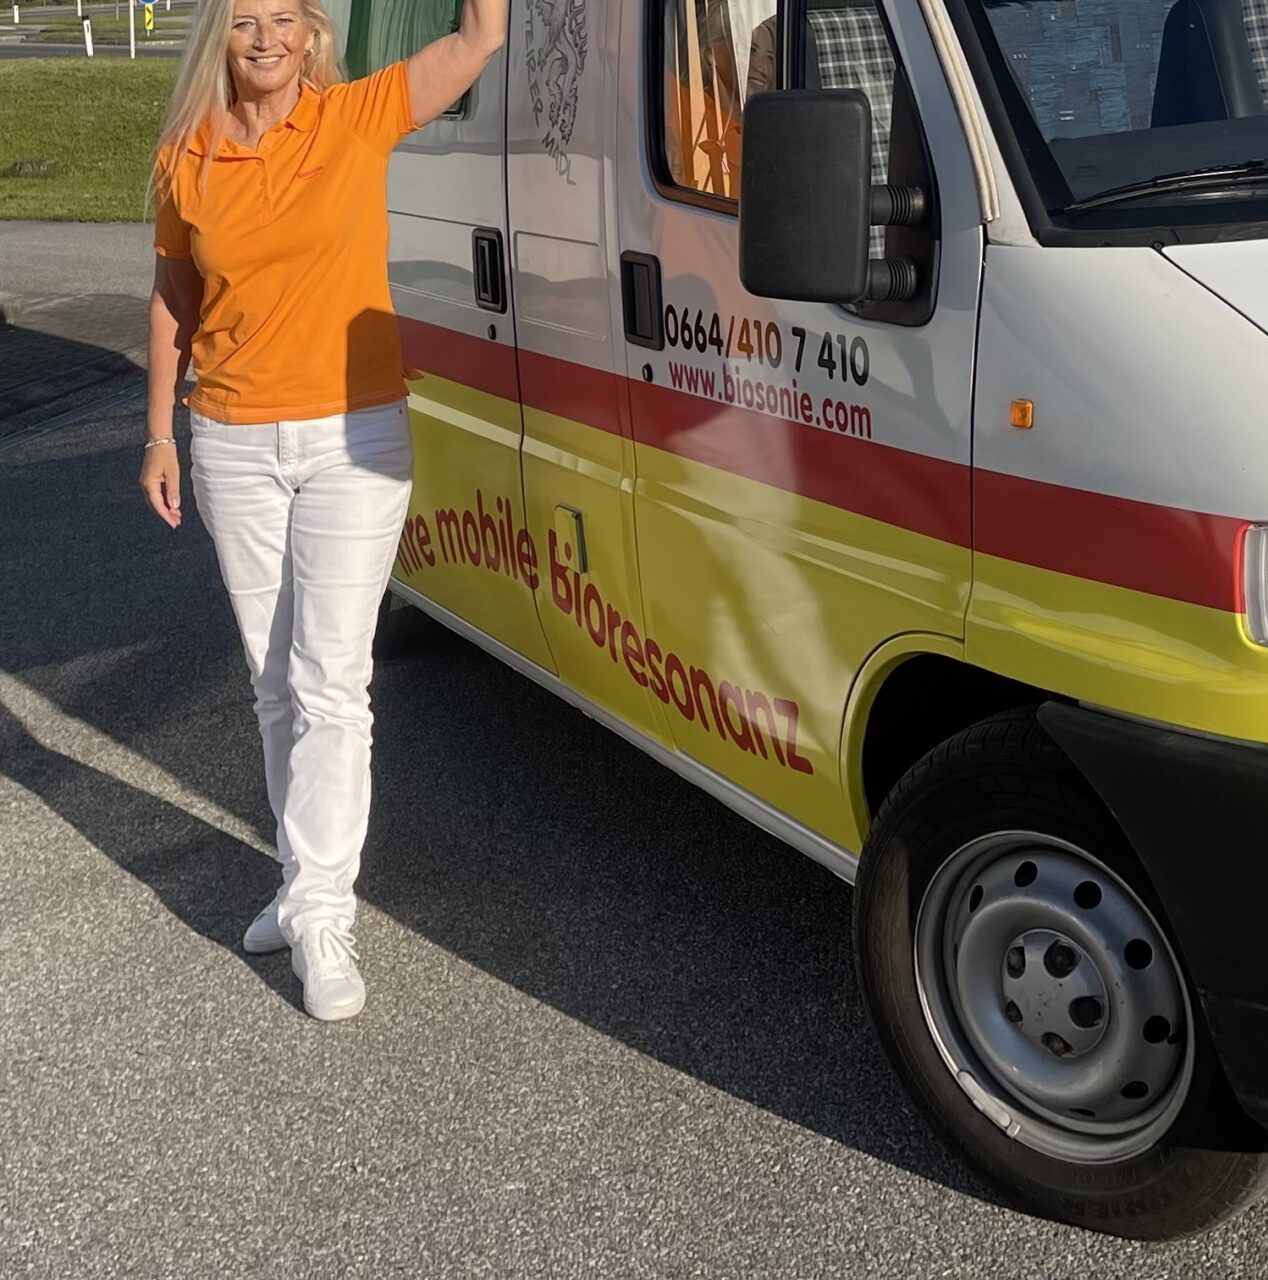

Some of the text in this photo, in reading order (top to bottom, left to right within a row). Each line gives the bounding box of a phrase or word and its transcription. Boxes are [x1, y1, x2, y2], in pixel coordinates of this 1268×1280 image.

[541, 131, 576, 186] MADL
[664, 304, 870, 387] 0664/410 7 410
[668, 361, 872, 439] www.biosonie.com
[435, 488, 540, 590] mobile
[548, 528, 814, 775] Bioresonanz
